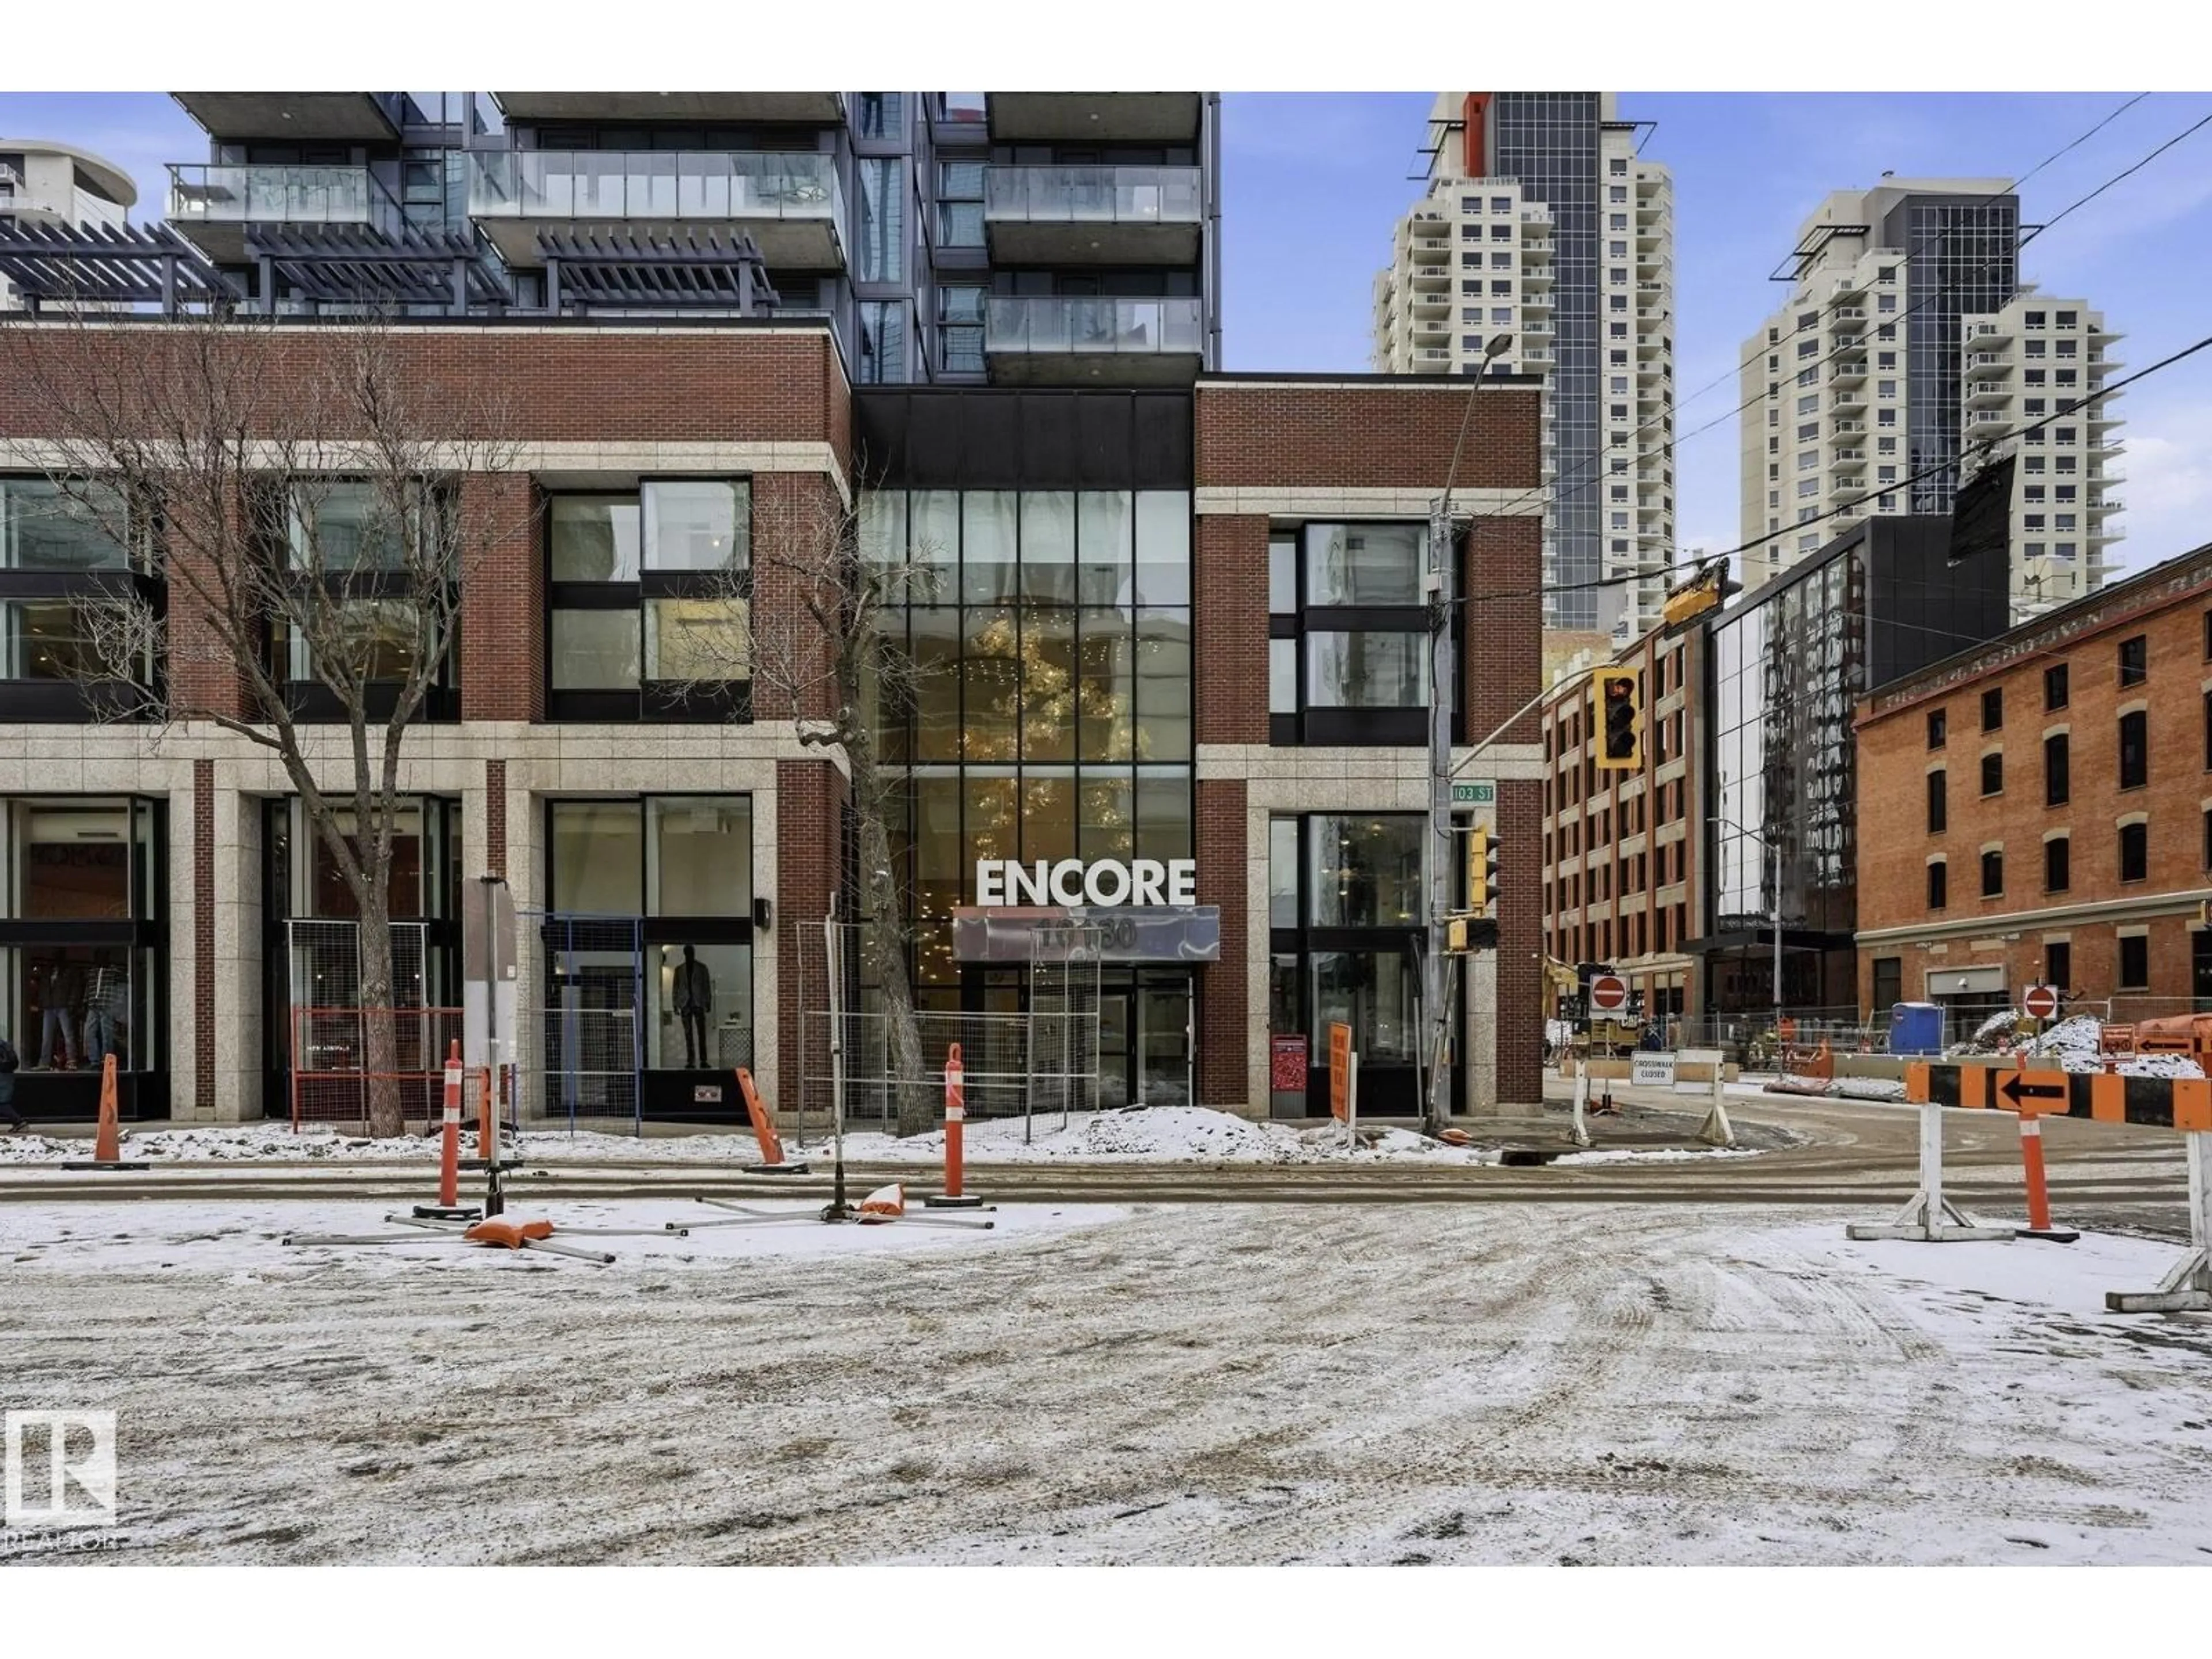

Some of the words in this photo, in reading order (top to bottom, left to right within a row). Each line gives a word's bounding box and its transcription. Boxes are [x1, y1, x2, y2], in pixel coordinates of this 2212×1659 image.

[1455, 787, 1474, 800] 103
[1478, 787, 1491, 800] ST
[976, 858, 1195, 906] ENCORE
